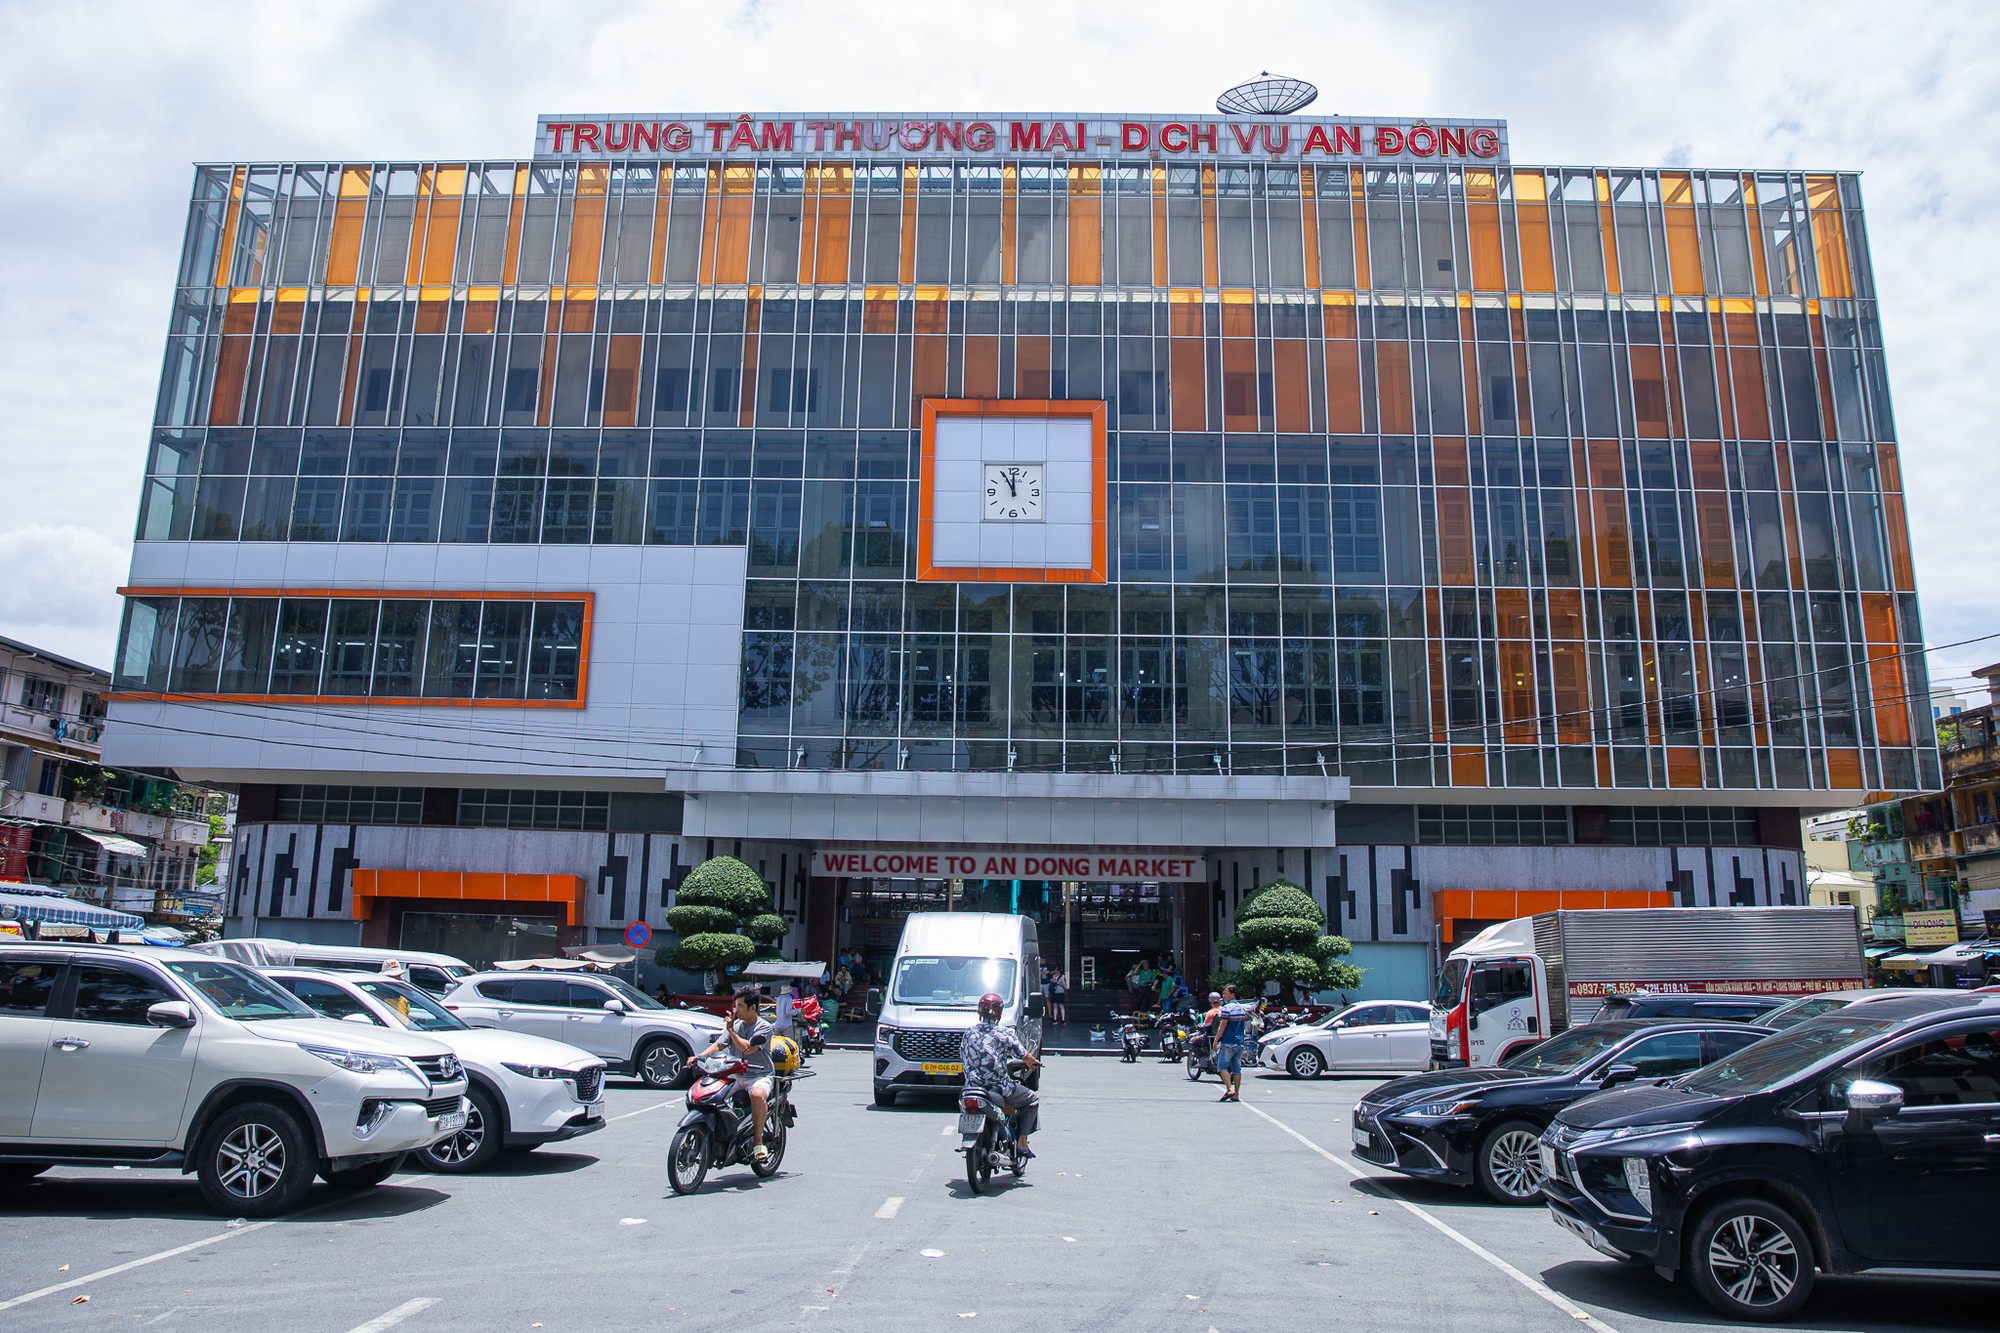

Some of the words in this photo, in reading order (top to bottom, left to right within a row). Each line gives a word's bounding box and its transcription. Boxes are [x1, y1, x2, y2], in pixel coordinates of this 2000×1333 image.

[546, 121, 691, 152] TRUNG
[705, 114, 793, 152] TÂM
[806, 120, 996, 152] THƯƠNG
[1010, 121, 1086, 158] MẠI
[1121, 122, 1219, 159] DỊCH
[1230, 123, 1291, 161] VỤ
[1301, 125, 1363, 156] AN
[1374, 118, 1500, 158] ĐÔNG
[1008, 510, 1018, 518] 6
[823, 853, 938, 874] WELCOME
[944, 855, 977, 874] TO
[983, 856, 1016, 875] AN
[1024, 857, 1090, 876] DONG
[1098, 858, 1196, 878] MARKET
[1577, 983, 1636, 995] 0937.75.552
